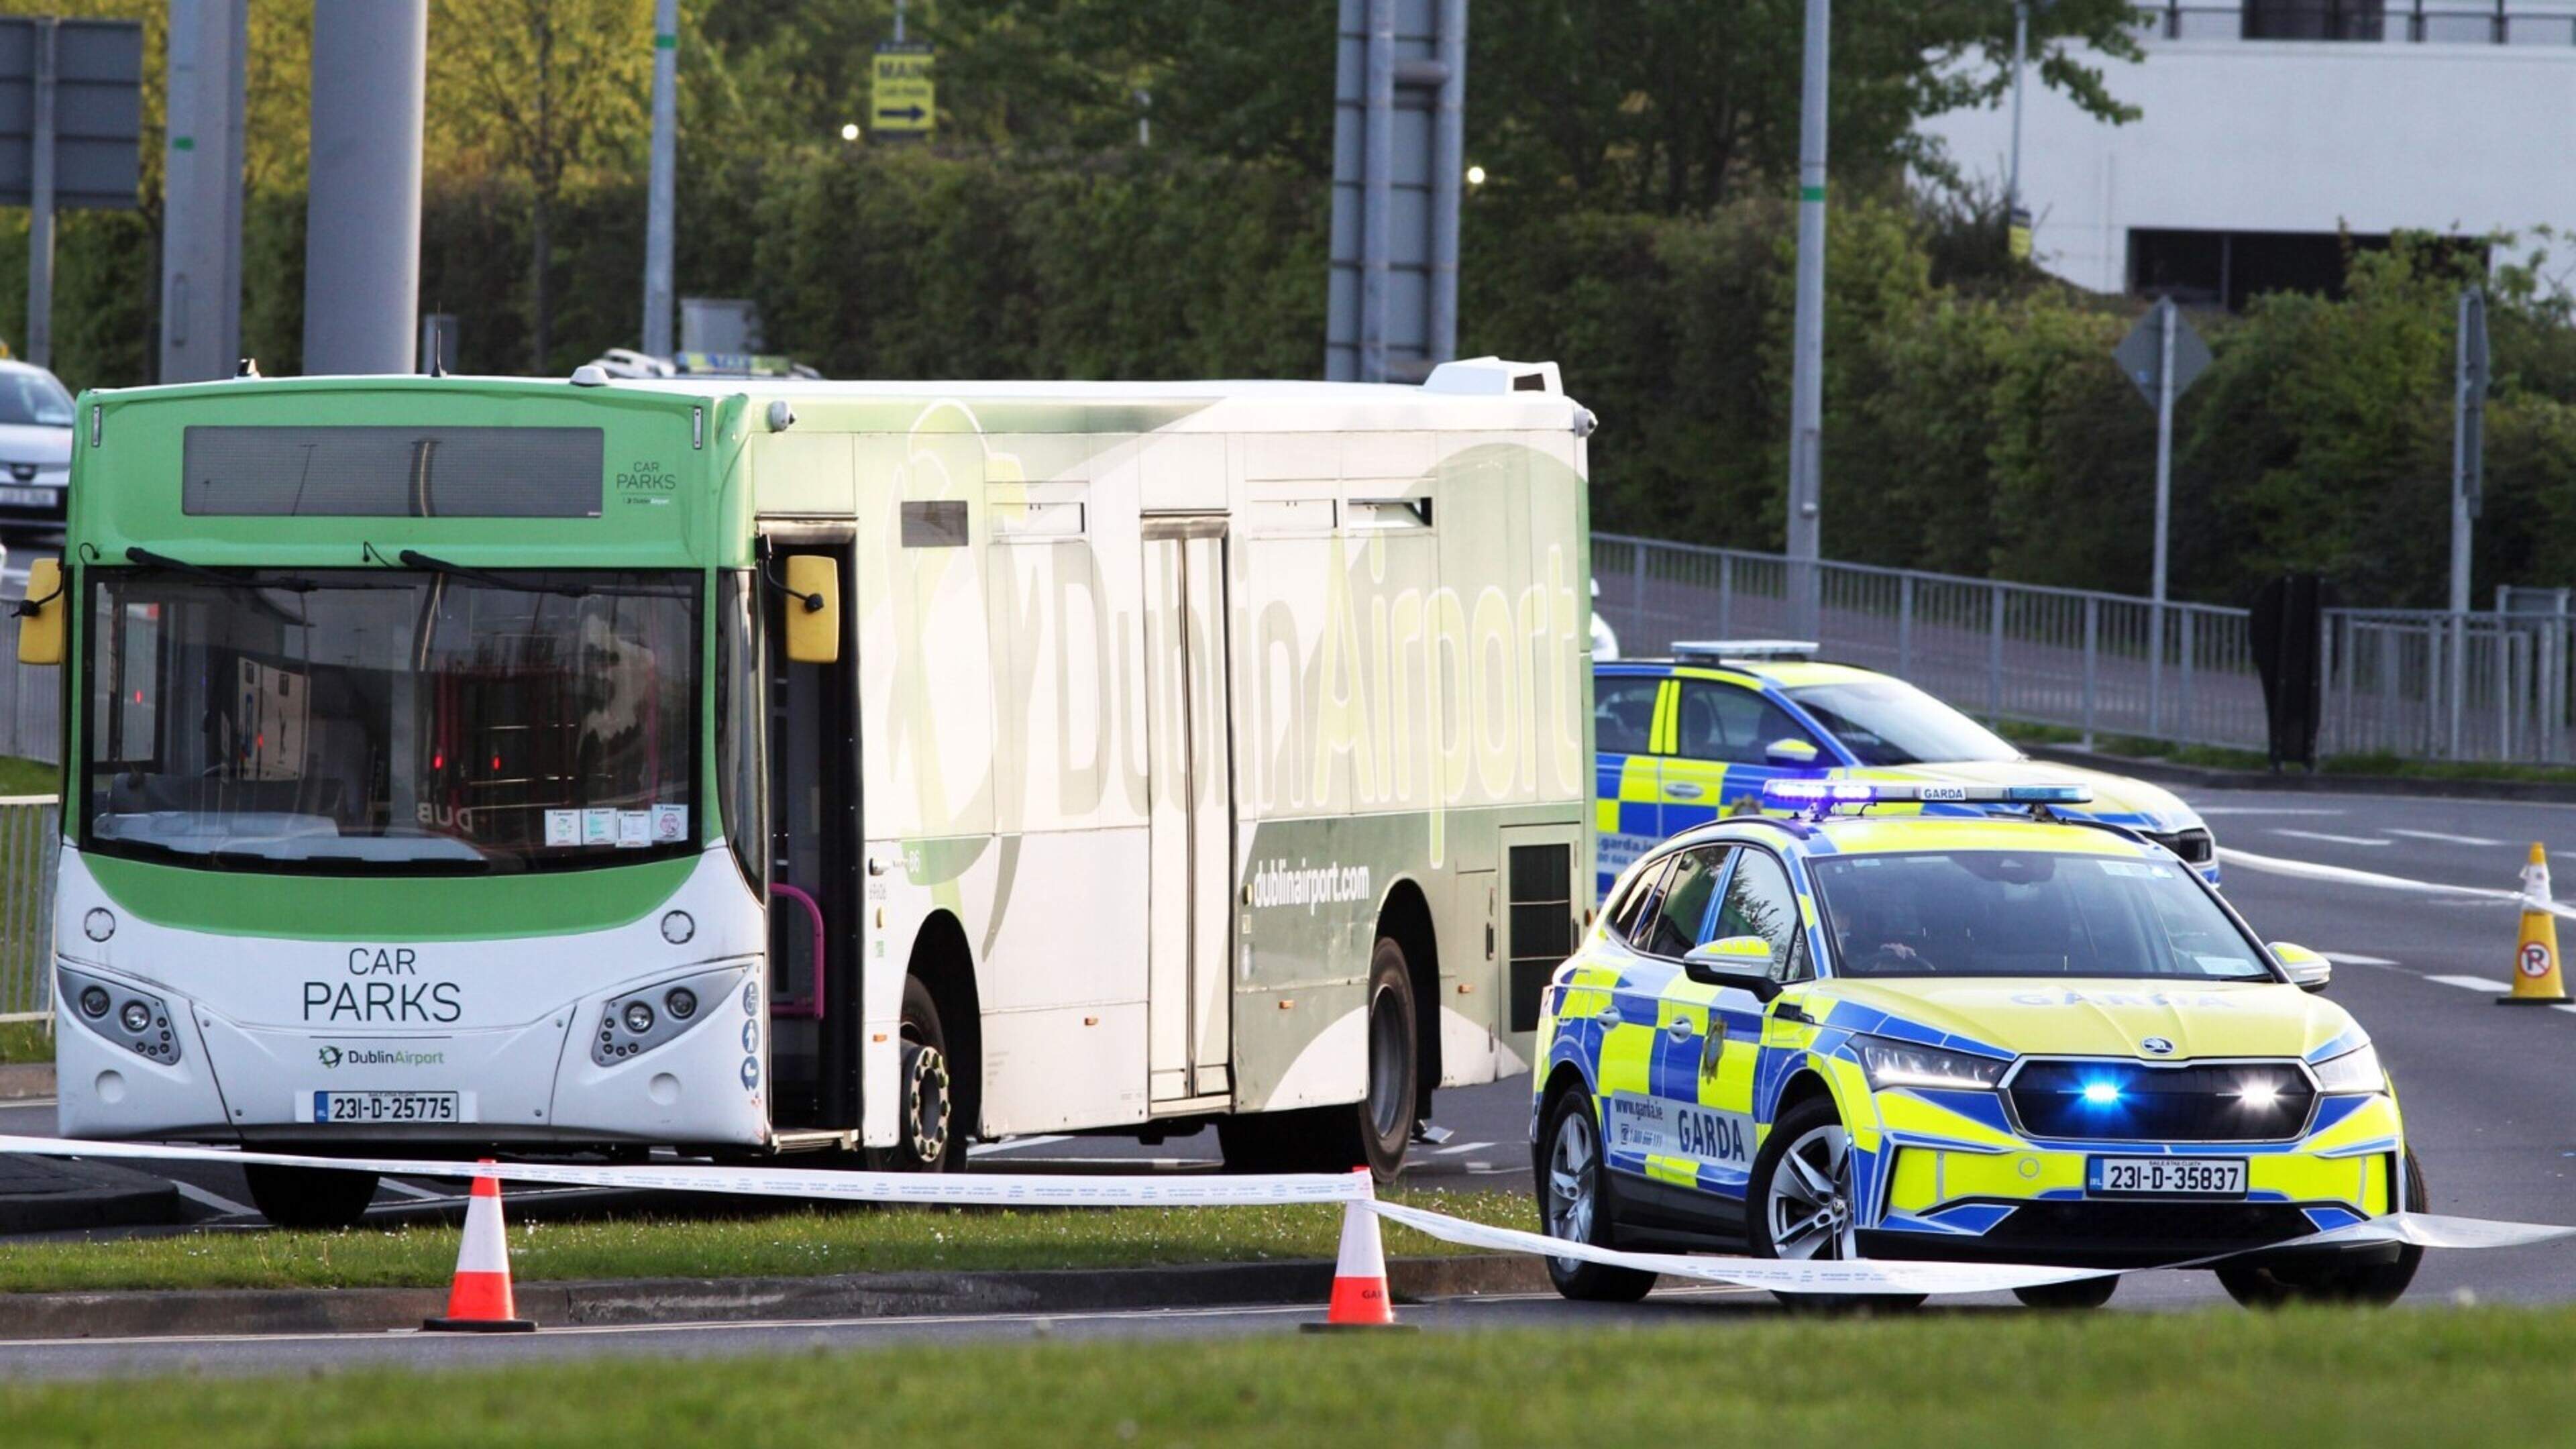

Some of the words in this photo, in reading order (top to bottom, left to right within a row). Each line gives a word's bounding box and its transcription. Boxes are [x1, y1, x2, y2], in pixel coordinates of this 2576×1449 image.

[633, 462, 659, 472] CAR
[616, 474, 676, 490] PARKS
[1924, 788, 1963, 798] GARDA
[1254, 857, 1370, 916] dublinairport.com
[349, 948, 416, 975] CAR
[304, 981, 462, 1022] PARKS
[348, 1050, 445, 1066] DublinAirport
[333, 1097, 451, 1119] 231-D-25775
[1678, 1110, 1746, 1163] GARDA
[2110, 1166, 2239, 1191] 231-D-35837
